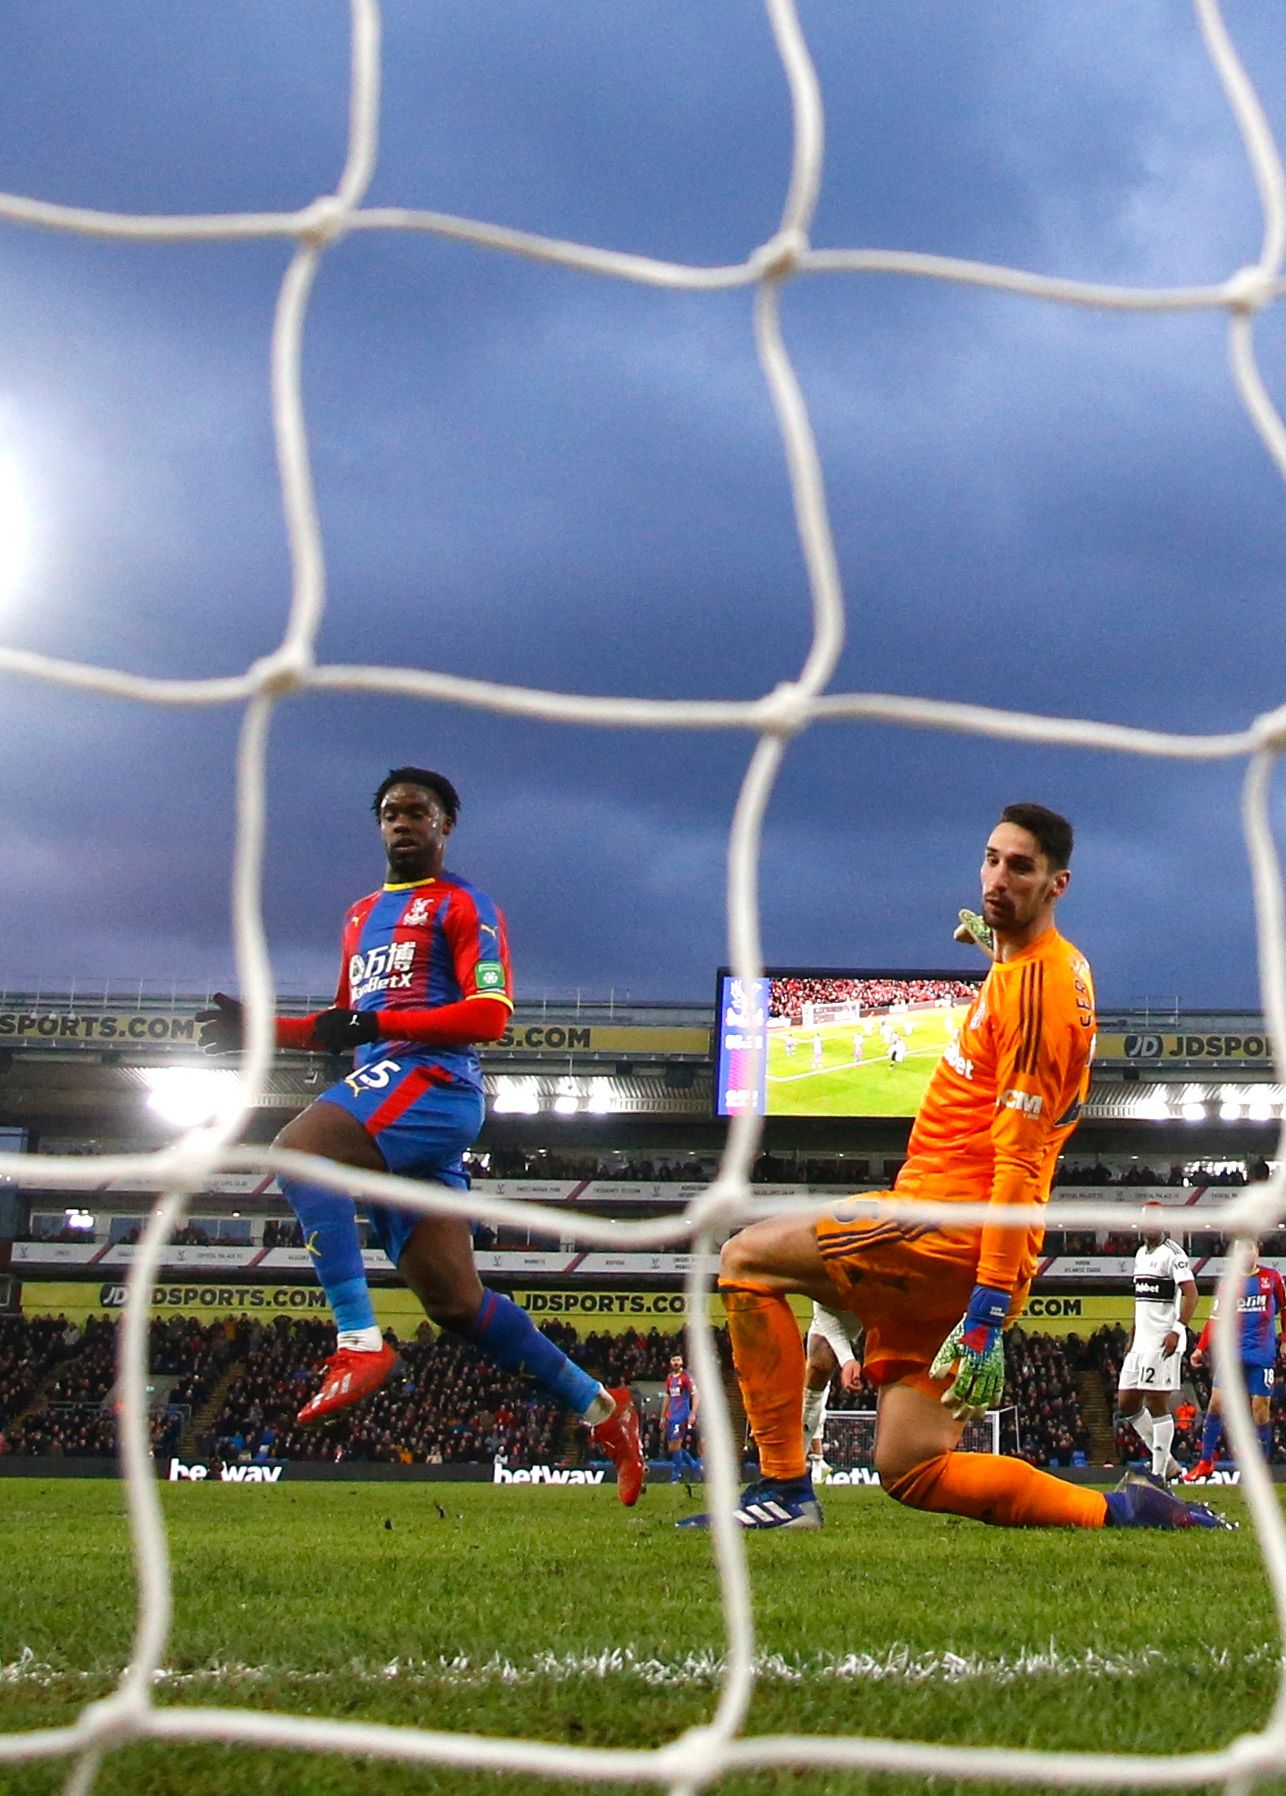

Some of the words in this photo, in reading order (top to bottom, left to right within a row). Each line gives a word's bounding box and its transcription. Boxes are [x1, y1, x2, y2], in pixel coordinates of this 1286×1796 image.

[1128, 1036, 1160, 1057] JD
[345, 1059, 402, 1089] 15
[151, 1287, 327, 1307] DSPORTS.COM
[521, 1292, 688, 1313] JDSPORTS.CO
[1141, 1366, 1155, 1384] 12
[170, 1458, 282, 1481] beway
